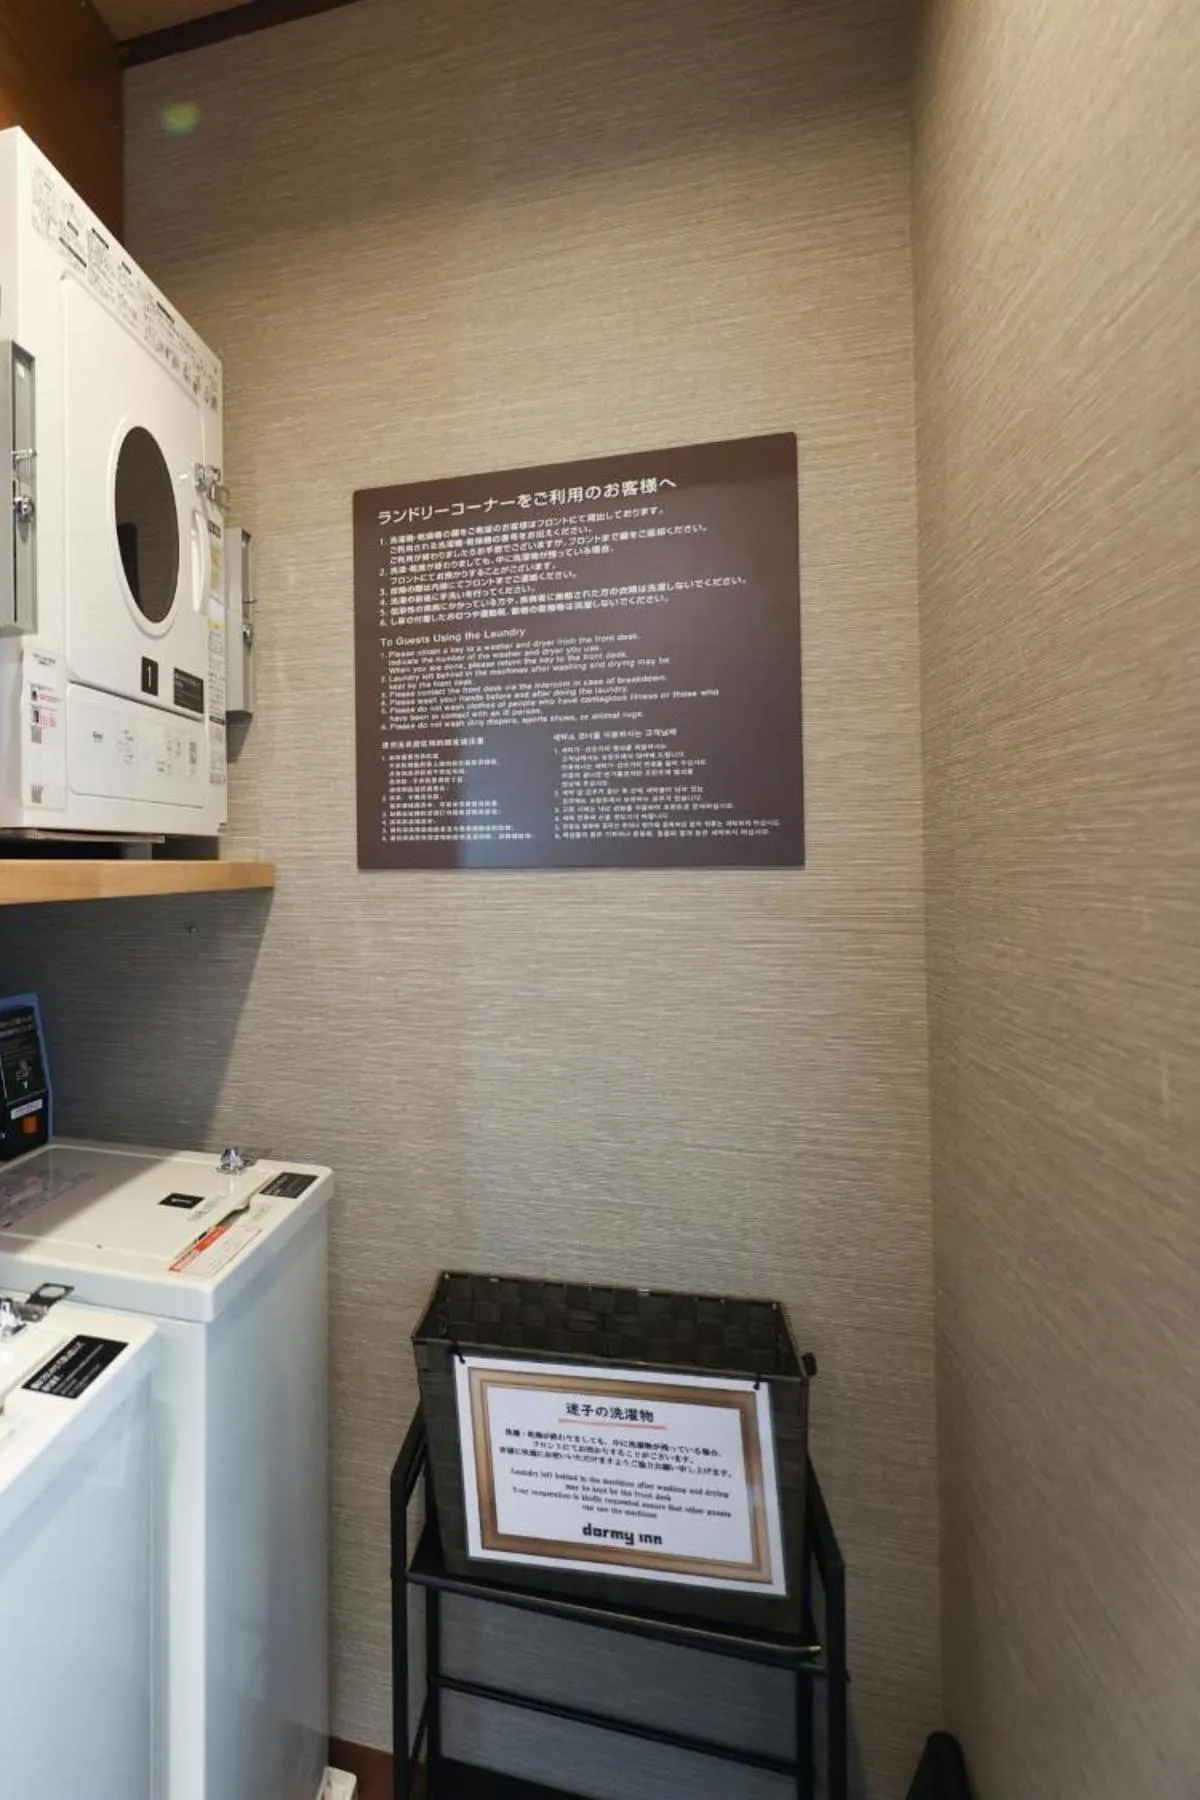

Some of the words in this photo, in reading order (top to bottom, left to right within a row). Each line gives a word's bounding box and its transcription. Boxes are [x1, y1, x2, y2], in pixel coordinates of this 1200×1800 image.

[378, 476, 677, 525] ランドリーコーナーをご利用のお客様へ
[380, 637, 392, 646] To
[395, 634, 430, 645] Guests
[432, 631, 461, 644] Using
[464, 630, 480, 639] the
[483, 626, 525, 640] Laundry
[565, 1402, 654, 1422] 迷子の洗濯物
[581, 1522, 634, 1545] dormy
[638, 1532, 662, 1545] inn
